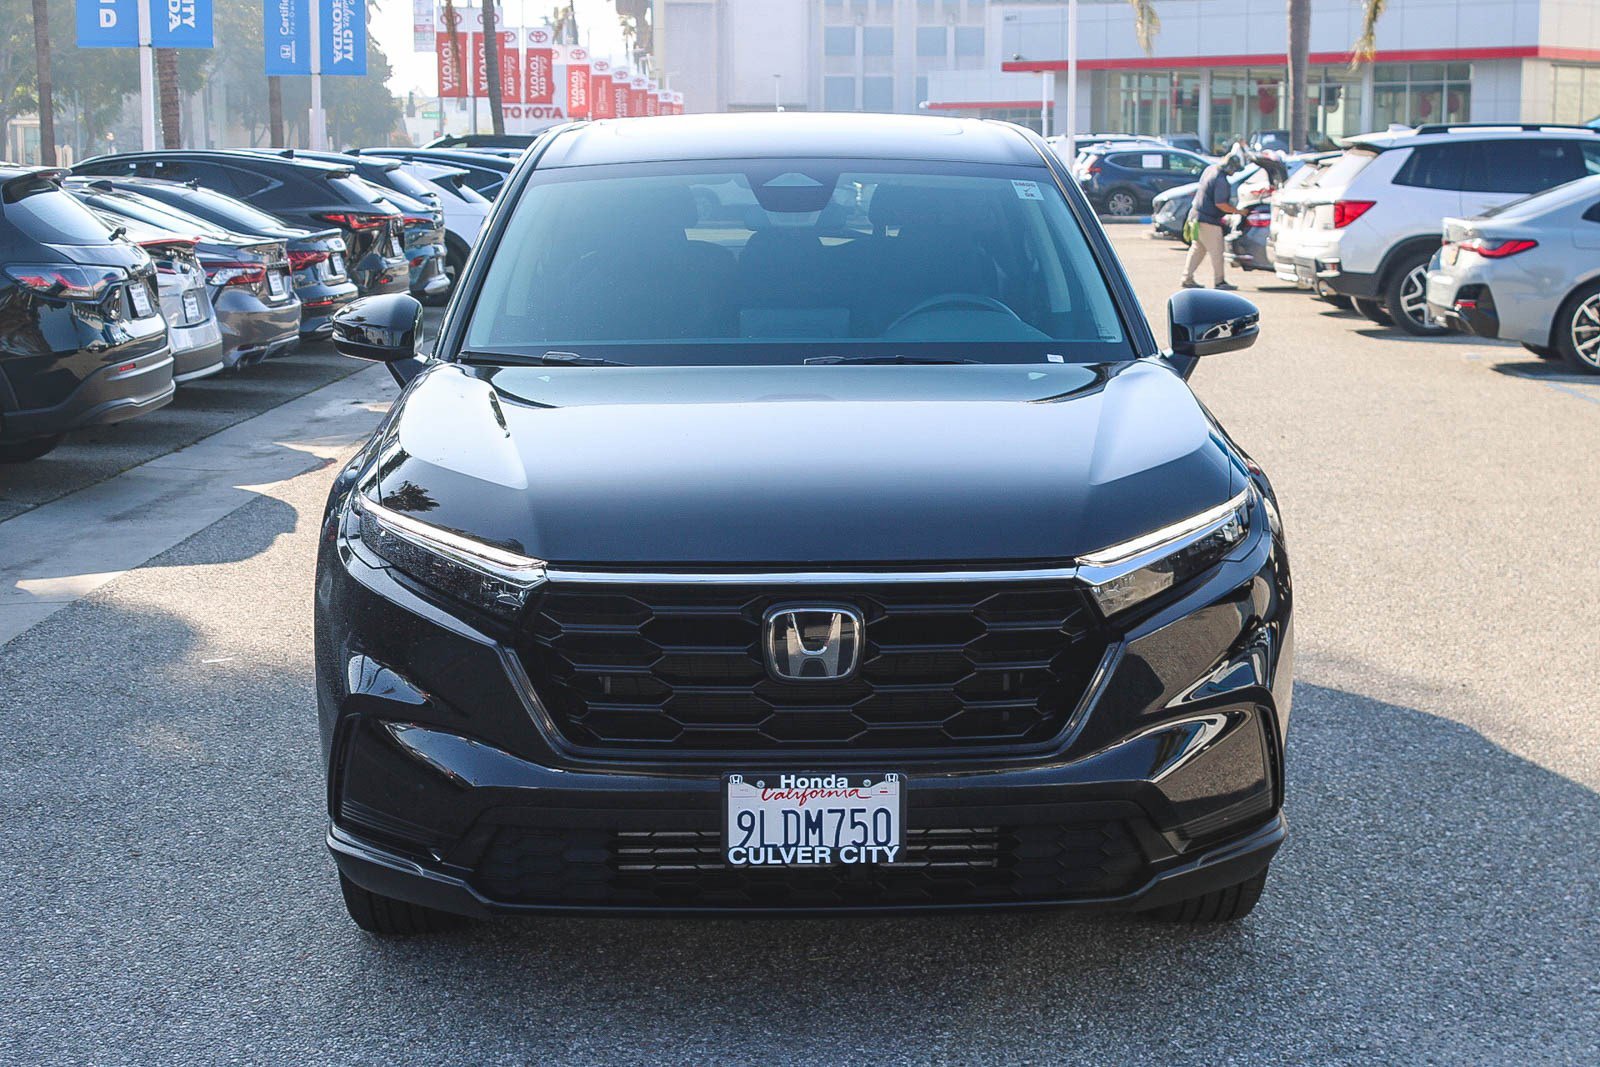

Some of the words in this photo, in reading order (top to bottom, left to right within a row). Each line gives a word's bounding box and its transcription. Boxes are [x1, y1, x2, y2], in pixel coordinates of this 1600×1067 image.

[343, 29, 353, 62] CITY
[441, 40, 453, 91] TOYOTA
[530, 55, 539, 98] TOYOTA
[501, 107, 563, 119] TOYOTA
[780, 774, 848, 788] Honda
[761, 786, 872, 806] California
[736, 807, 893, 847] 9LDM750
[728, 846, 831, 865] CULVER
[839, 845, 899, 865] CITY
